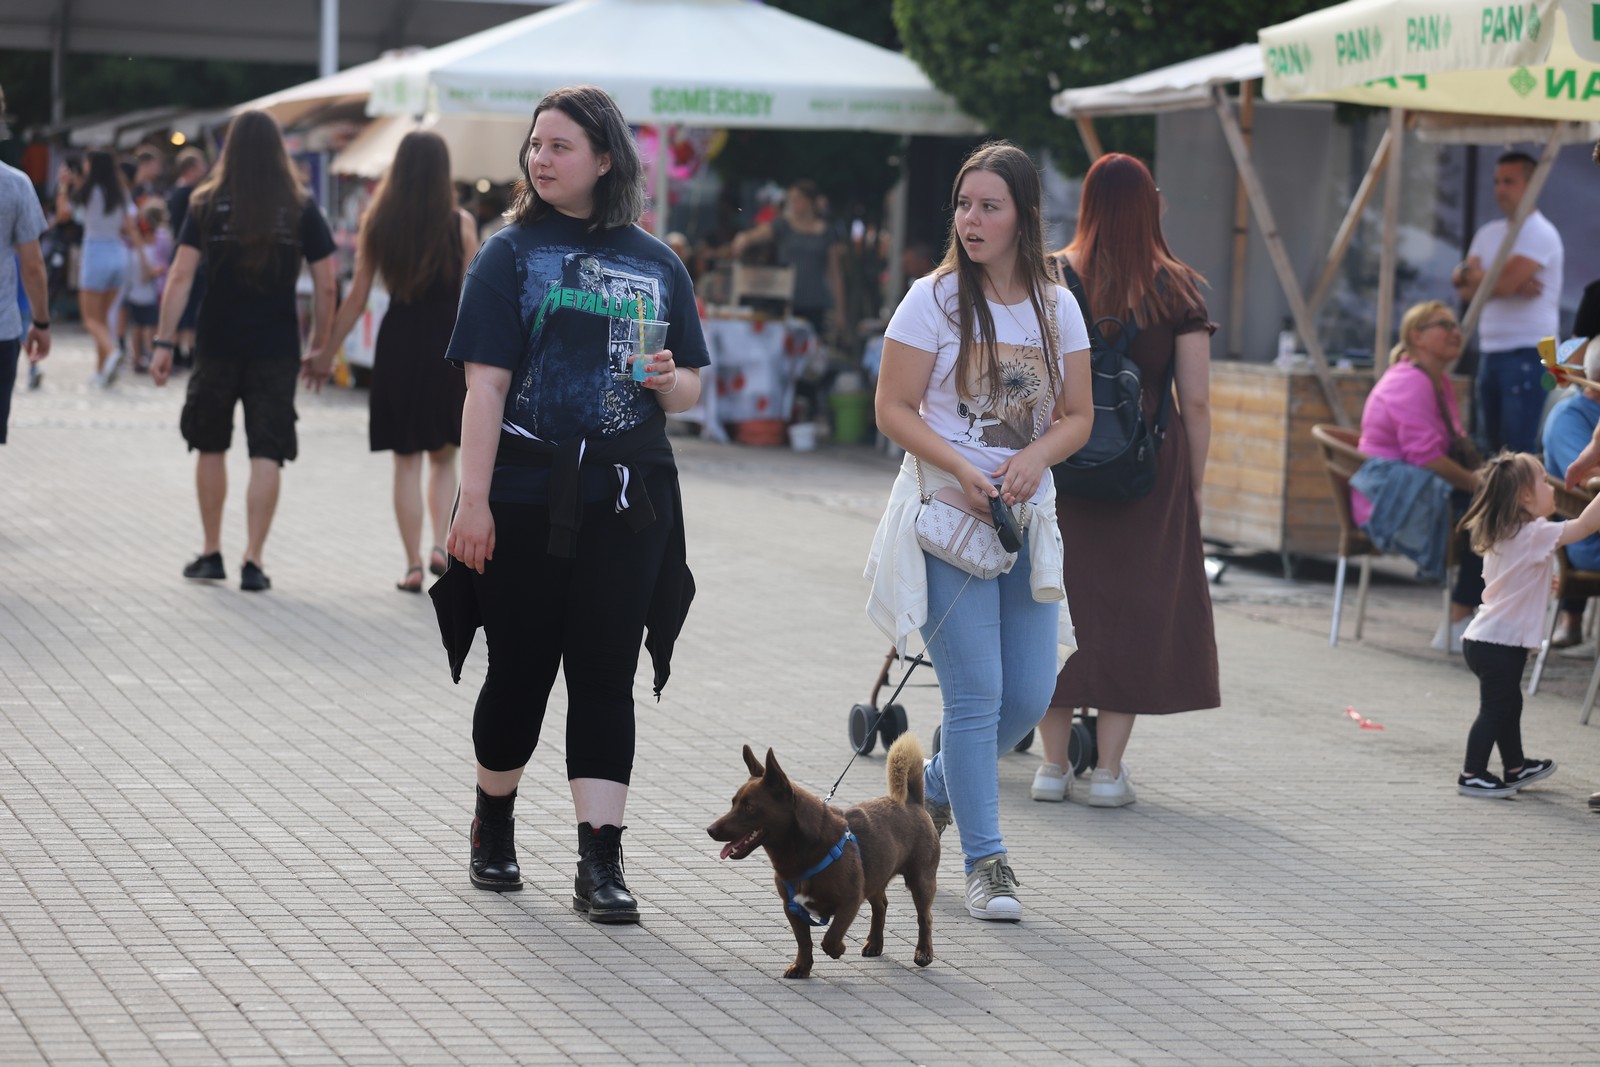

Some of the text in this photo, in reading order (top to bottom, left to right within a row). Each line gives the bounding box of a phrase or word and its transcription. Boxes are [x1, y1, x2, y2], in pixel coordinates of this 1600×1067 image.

[1406, 13, 1440, 53] PAN
[1481, 5, 1524, 45] PAN
[1335, 26, 1370, 67] PAN
[650, 86, 775, 118] SOMERSBY
